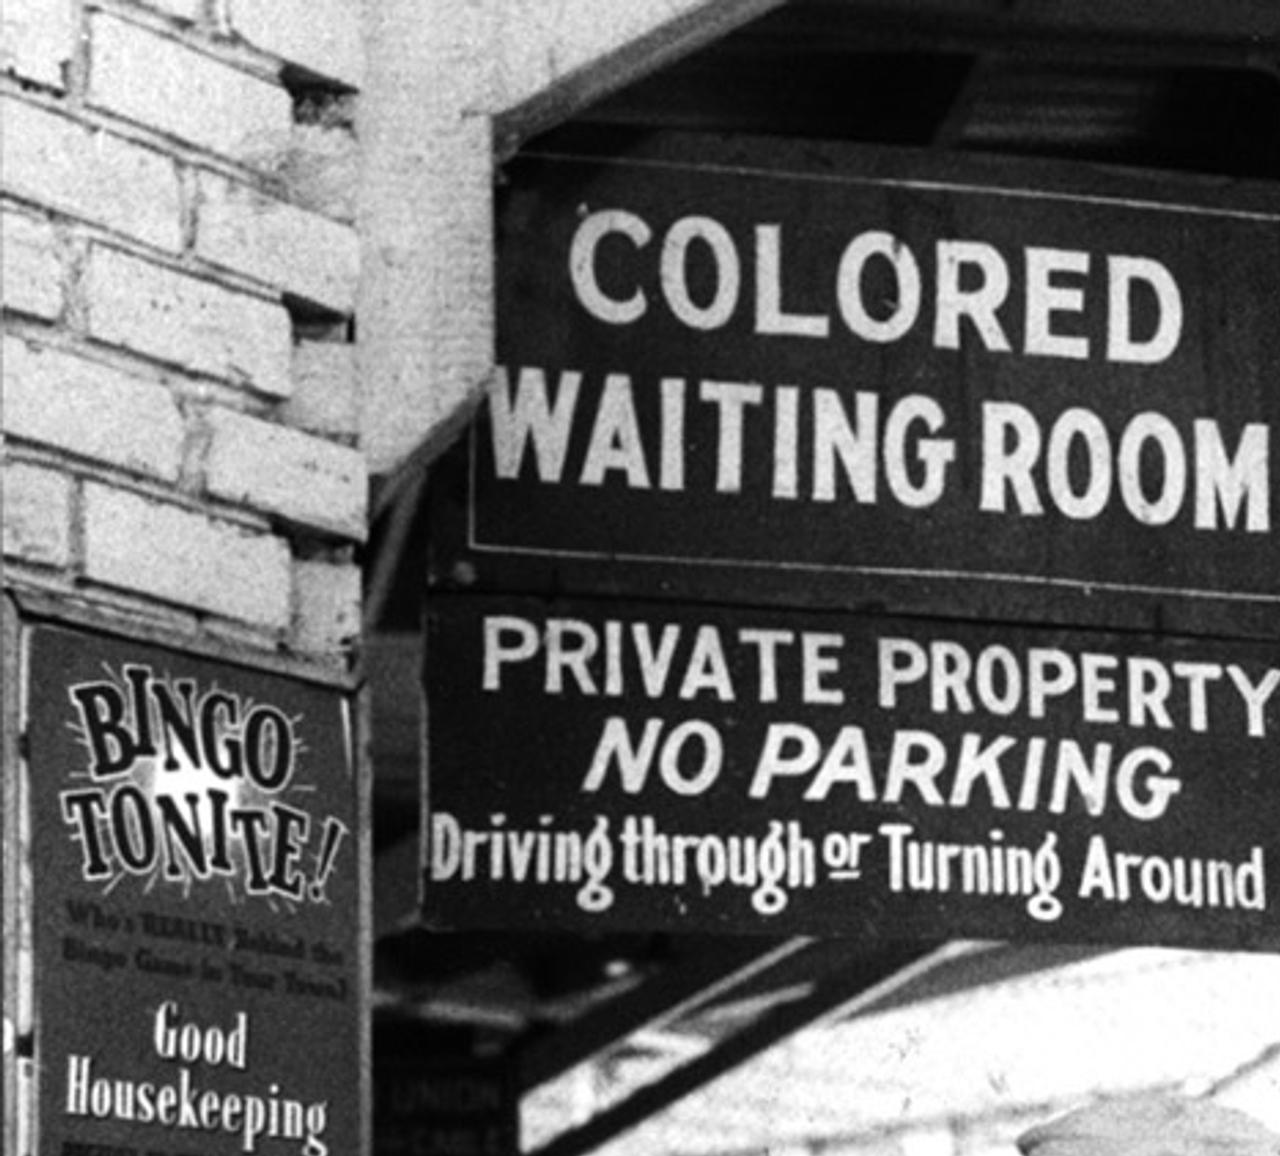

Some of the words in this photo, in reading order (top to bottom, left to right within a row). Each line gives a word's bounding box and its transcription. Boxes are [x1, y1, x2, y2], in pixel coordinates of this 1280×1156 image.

[569, 210, 1182, 364] COLORED
[486, 366, 955, 507] WAITING
[980, 401, 1270, 532] ROOM
[482, 615, 844, 705] PRIVATE
[70, 664, 295, 792] BINGO
[582, 718, 722, 795] NO
[748, 723, 1181, 820] PARKING
[61, 786, 348, 900] TONITE!
[430, 812, 611, 912] Driving
[620, 818, 814, 914] through
[824, 832, 870, 880] or
[879, 823, 1063, 921] Turning
[1078, 834, 1265, 911] Around
[154, 1000, 247, 1069] Good
